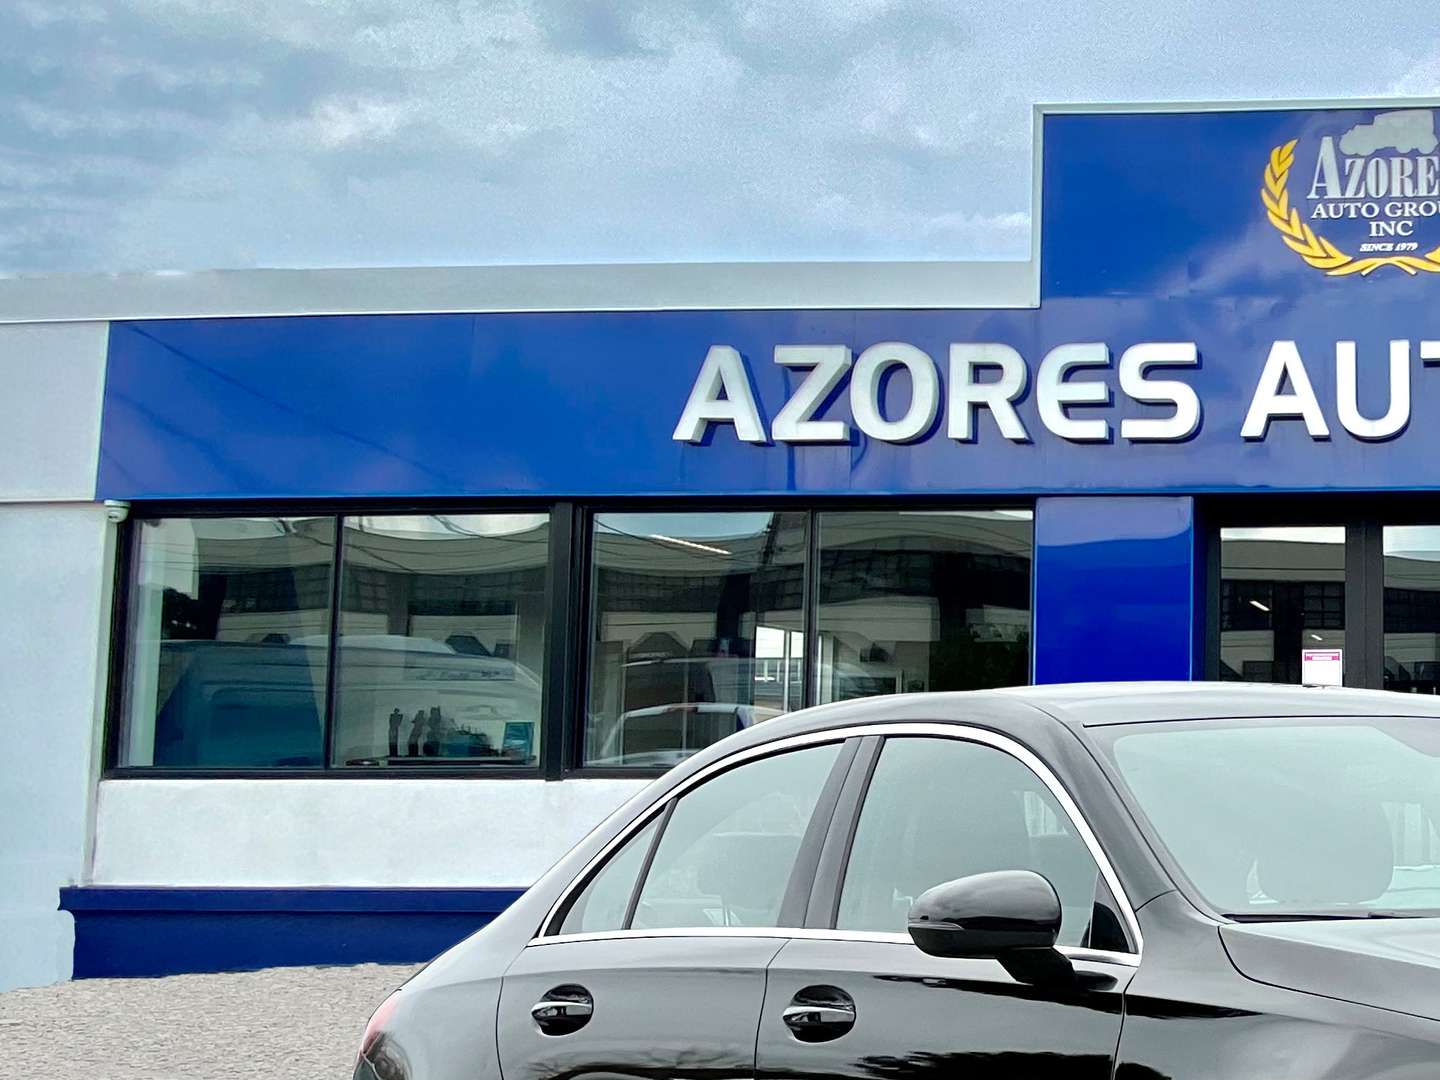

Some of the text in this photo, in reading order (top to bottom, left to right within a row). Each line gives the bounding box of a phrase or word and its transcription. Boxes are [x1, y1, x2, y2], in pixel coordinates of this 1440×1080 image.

[1310, 202, 1380, 219] AUTO
[1369, 220, 1414, 237] INC
[1359, 242, 1419, 252] SINCE 1979
[672, 342, 1200, 445] AZORES
